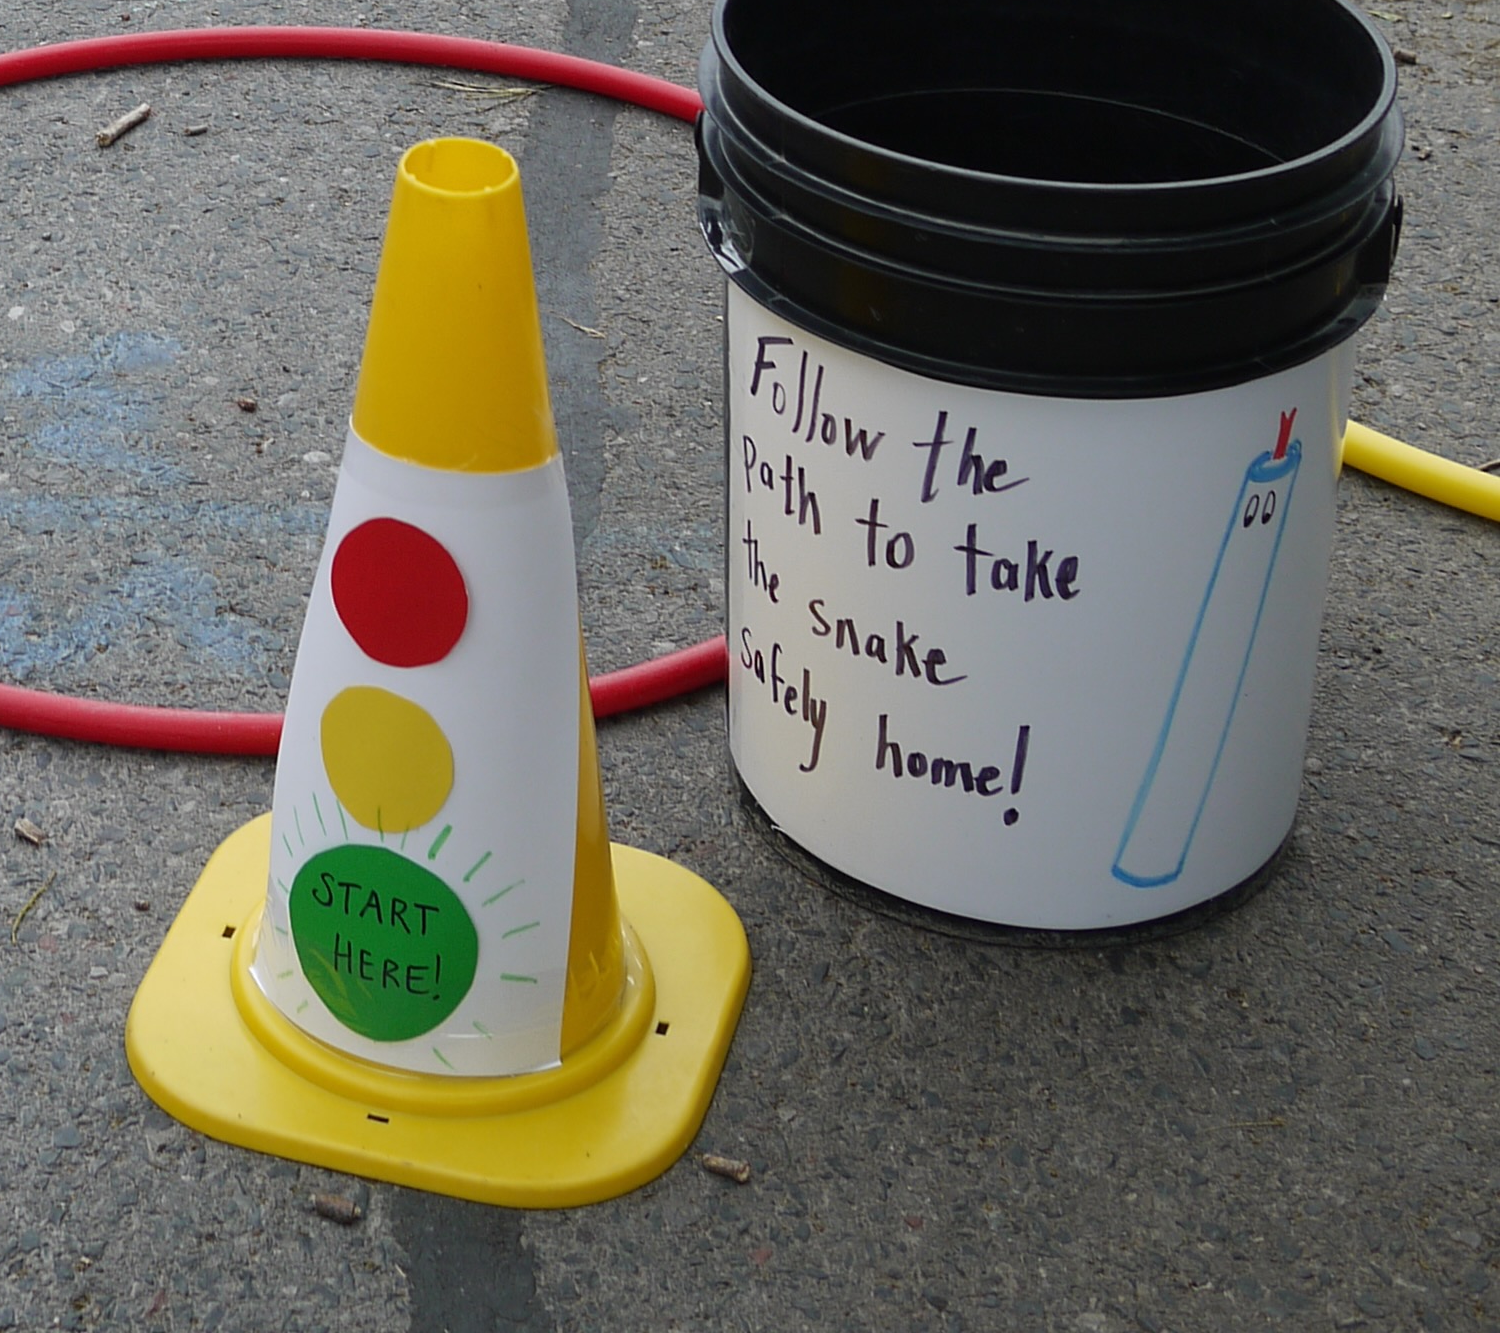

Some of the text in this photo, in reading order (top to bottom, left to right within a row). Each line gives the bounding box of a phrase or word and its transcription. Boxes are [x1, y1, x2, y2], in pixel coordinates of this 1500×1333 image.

[750, 336, 1031, 503] Follow the
[742, 519, 968, 686] the snake
[855, 497, 915, 569] to
[953, 523, 1081, 603] take
[741, 627, 1031, 827] safely home!
[312, 872, 440, 936] START
[334, 932, 441, 1001] HERE!
